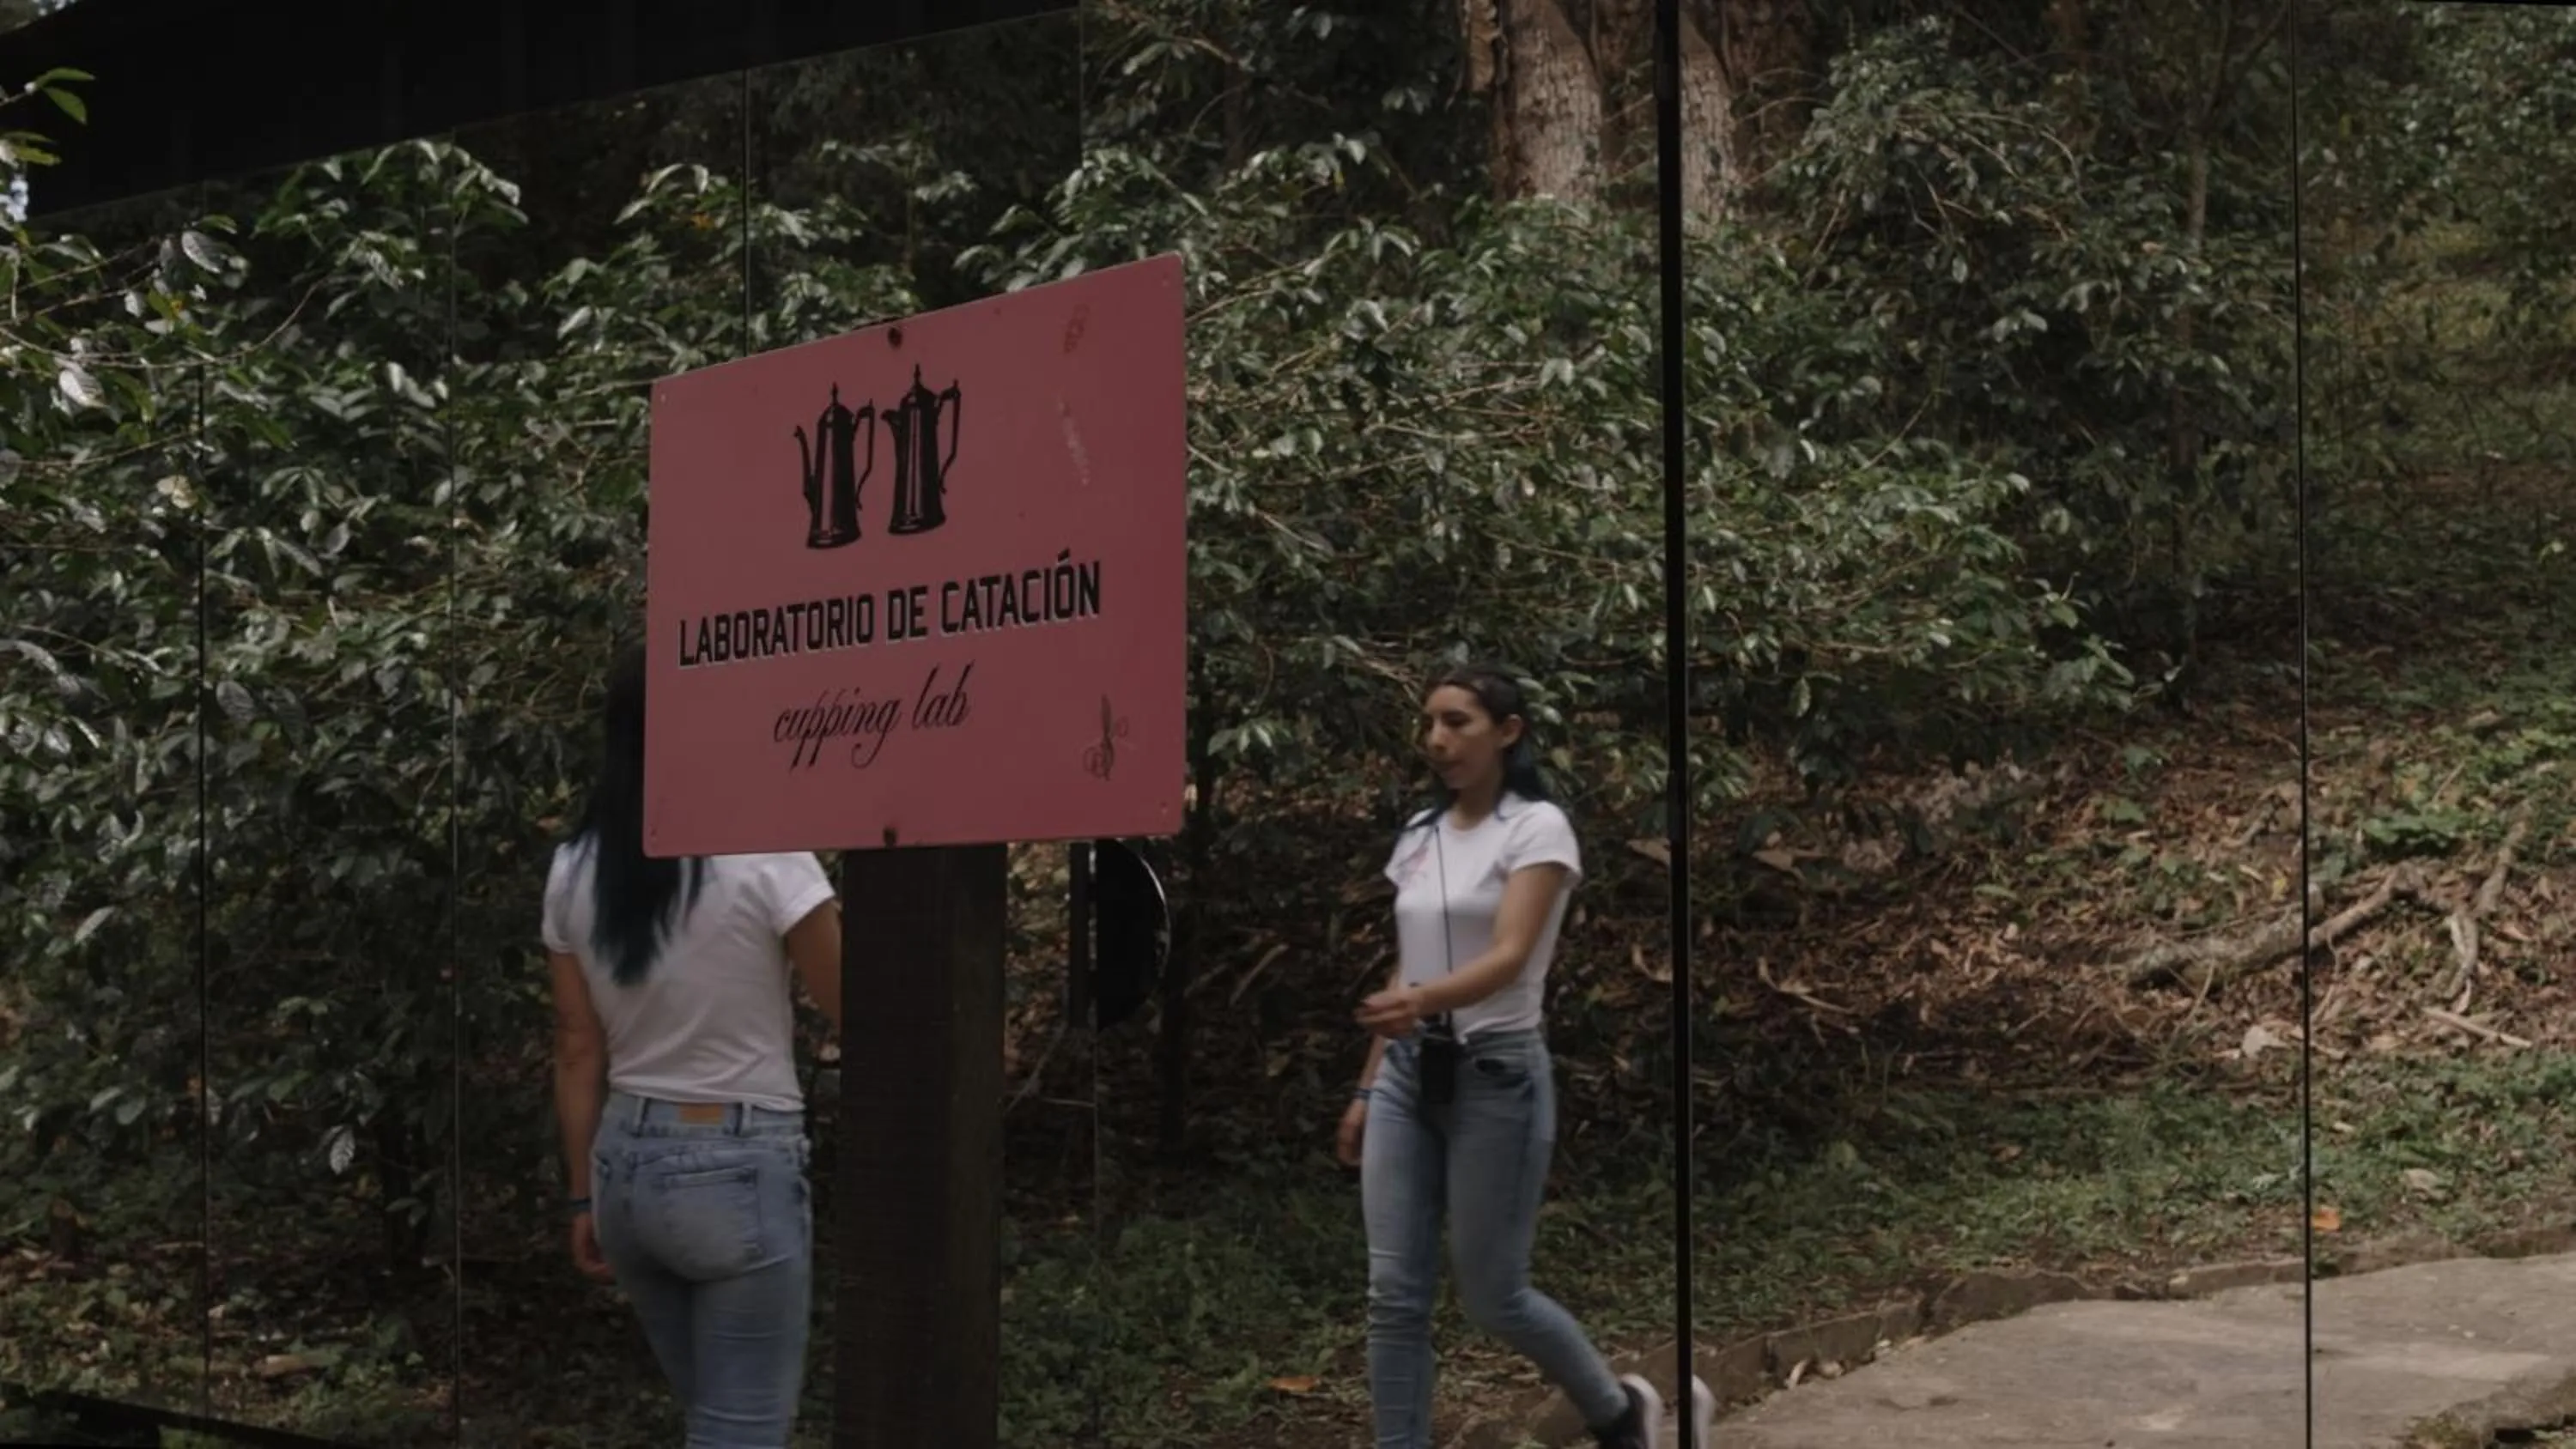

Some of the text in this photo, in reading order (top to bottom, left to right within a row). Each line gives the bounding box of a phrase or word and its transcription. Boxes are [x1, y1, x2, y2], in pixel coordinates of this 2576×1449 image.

[678, 549, 1101, 667] LABORATORIO DE CATACIÓN
[773, 658, 976, 772] cupping lab
